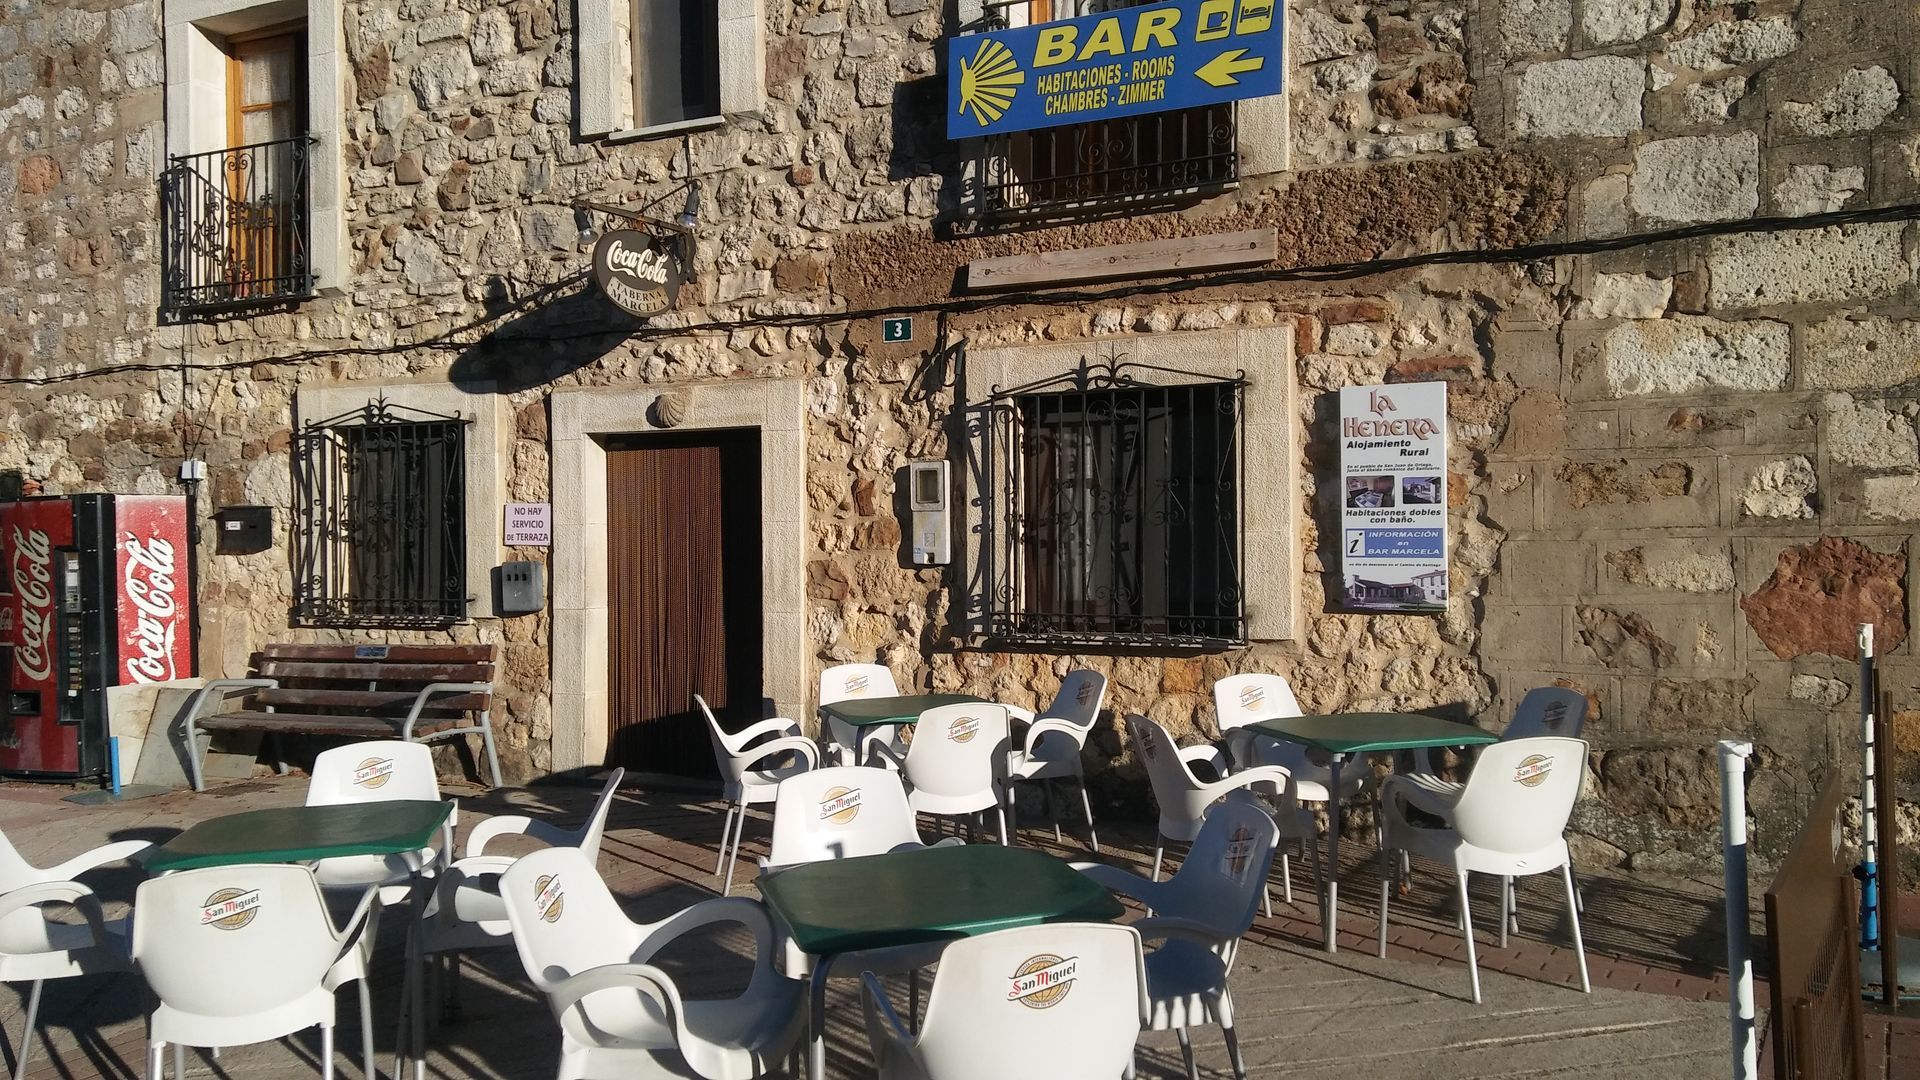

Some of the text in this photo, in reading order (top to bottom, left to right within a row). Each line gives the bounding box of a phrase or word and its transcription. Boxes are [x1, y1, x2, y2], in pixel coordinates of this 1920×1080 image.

[1032, 7, 1182, 68] BAR
[1037, 63, 1122, 95] HABITACIONES
[1131, 55, 1175, 81] ROOMS
[1045, 87, 1108, 116] CHAMBRES
[1117, 79, 1165, 105] ZIMMER
[606, 240, 669, 284] Coca-Cola
[612, 289, 667, 312] MARCELA
[616, 280, 663, 302] TABERNA
[894, 322, 903, 338] 3
[1346, 440, 1411, 450] Alojamiento
[1400, 448, 1429, 457] Rural
[514, 507, 543, 515] NO HAY
[1409, 508, 1441, 516] dobles
[512, 520, 544, 529] SERVICIO
[515, 533, 549, 541] TERRAZA
[13, 523, 50, 681] Coca-Cola
[124, 530, 177, 686] Coca-Cola
[1008, 962, 1076, 998] San Miguel
